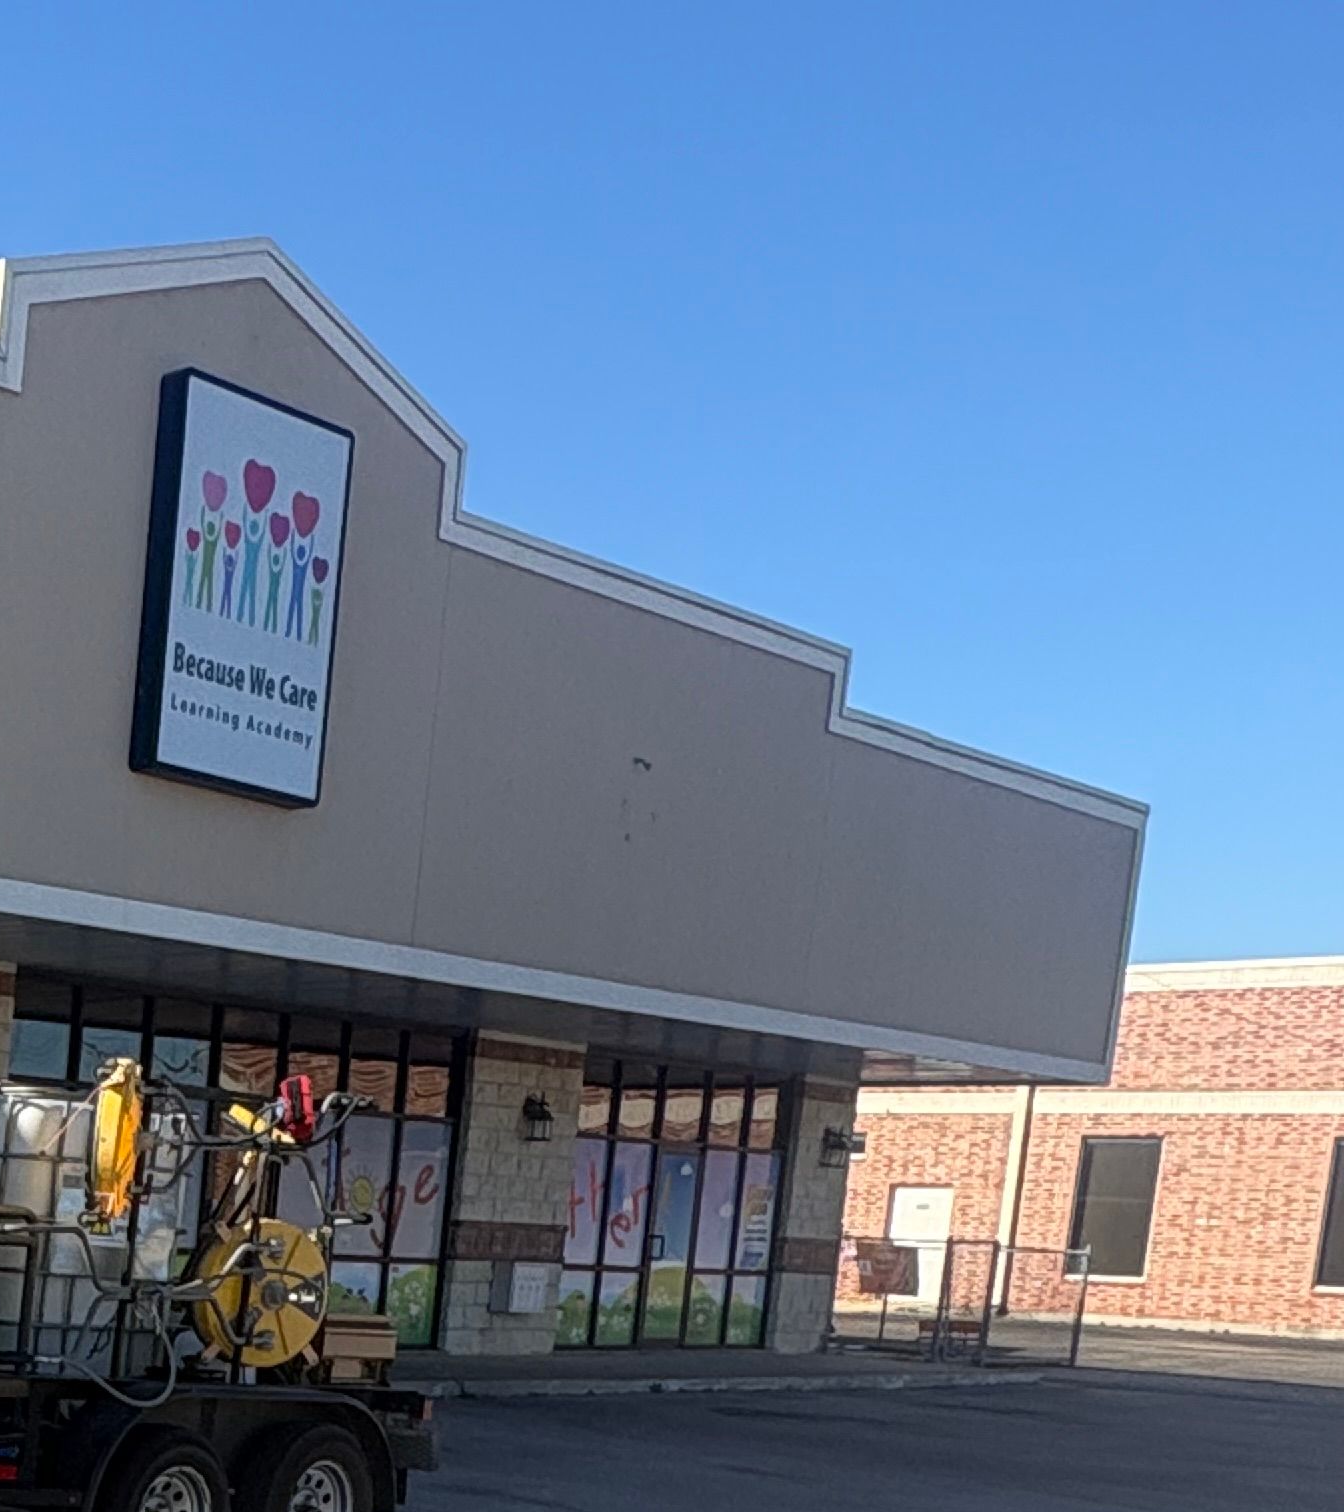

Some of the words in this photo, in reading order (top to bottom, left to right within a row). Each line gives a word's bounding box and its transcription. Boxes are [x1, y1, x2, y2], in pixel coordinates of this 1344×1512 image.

[173, 642, 246, 692] Because
[249, 664, 277, 700] We
[278, 675, 318, 713] Care
[170, 692, 240, 731] Learning
[246, 714, 313, 750] Academy
